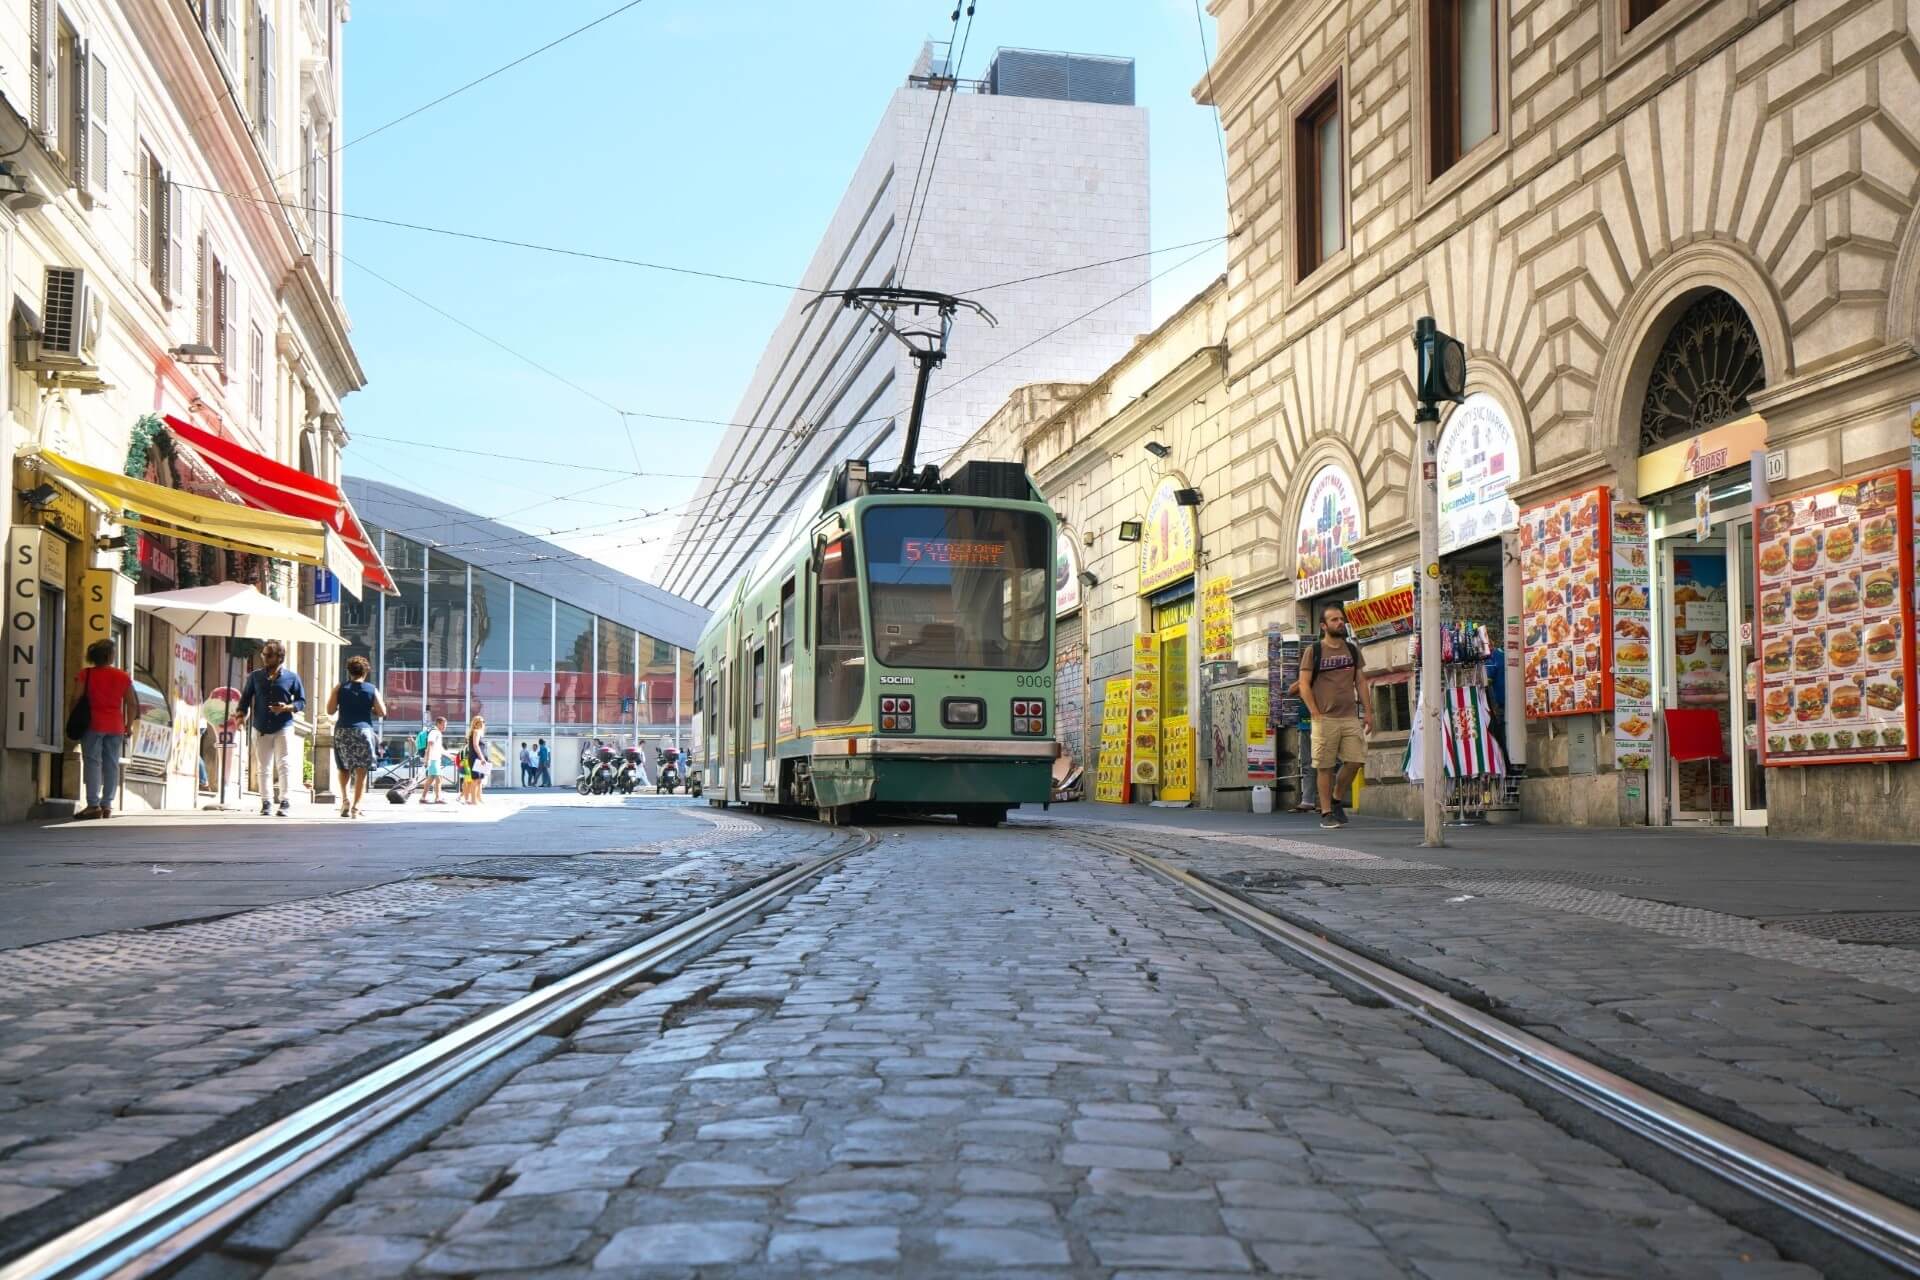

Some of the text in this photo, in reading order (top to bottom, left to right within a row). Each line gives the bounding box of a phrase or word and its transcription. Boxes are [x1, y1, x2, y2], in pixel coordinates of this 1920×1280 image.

[1695, 449, 1728, 473] BROAST
[1769, 458, 1781, 476] 10
[905, 543, 921, 561] 5
[1299, 562, 1360, 596] SUPERMARKET
[1368, 590, 1413, 622] TRANSFER
[13, 545, 36, 731] SCONTI
[1016, 675, 1052, 688] 9006
